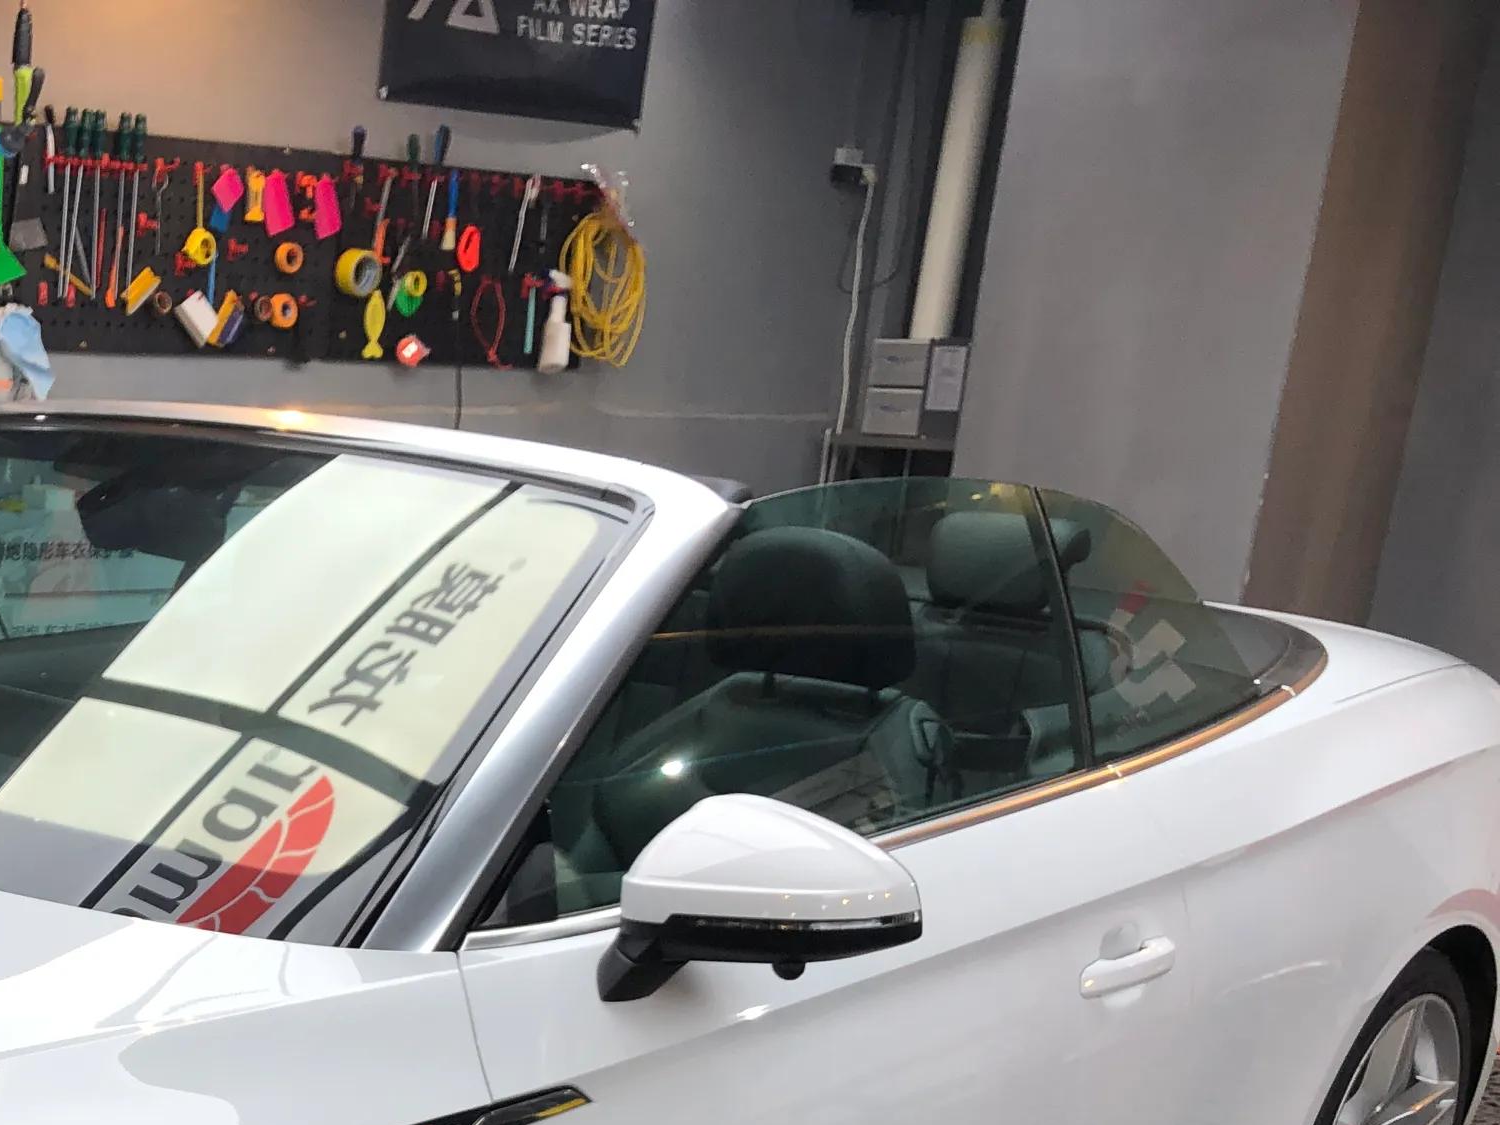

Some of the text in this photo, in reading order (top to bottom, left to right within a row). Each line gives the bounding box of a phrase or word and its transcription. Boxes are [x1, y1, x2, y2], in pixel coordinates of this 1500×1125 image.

[569, 0, 631, 19] WRAP
[516, 15, 564, 43] FILM
[572, 22, 638, 50] SERIES
